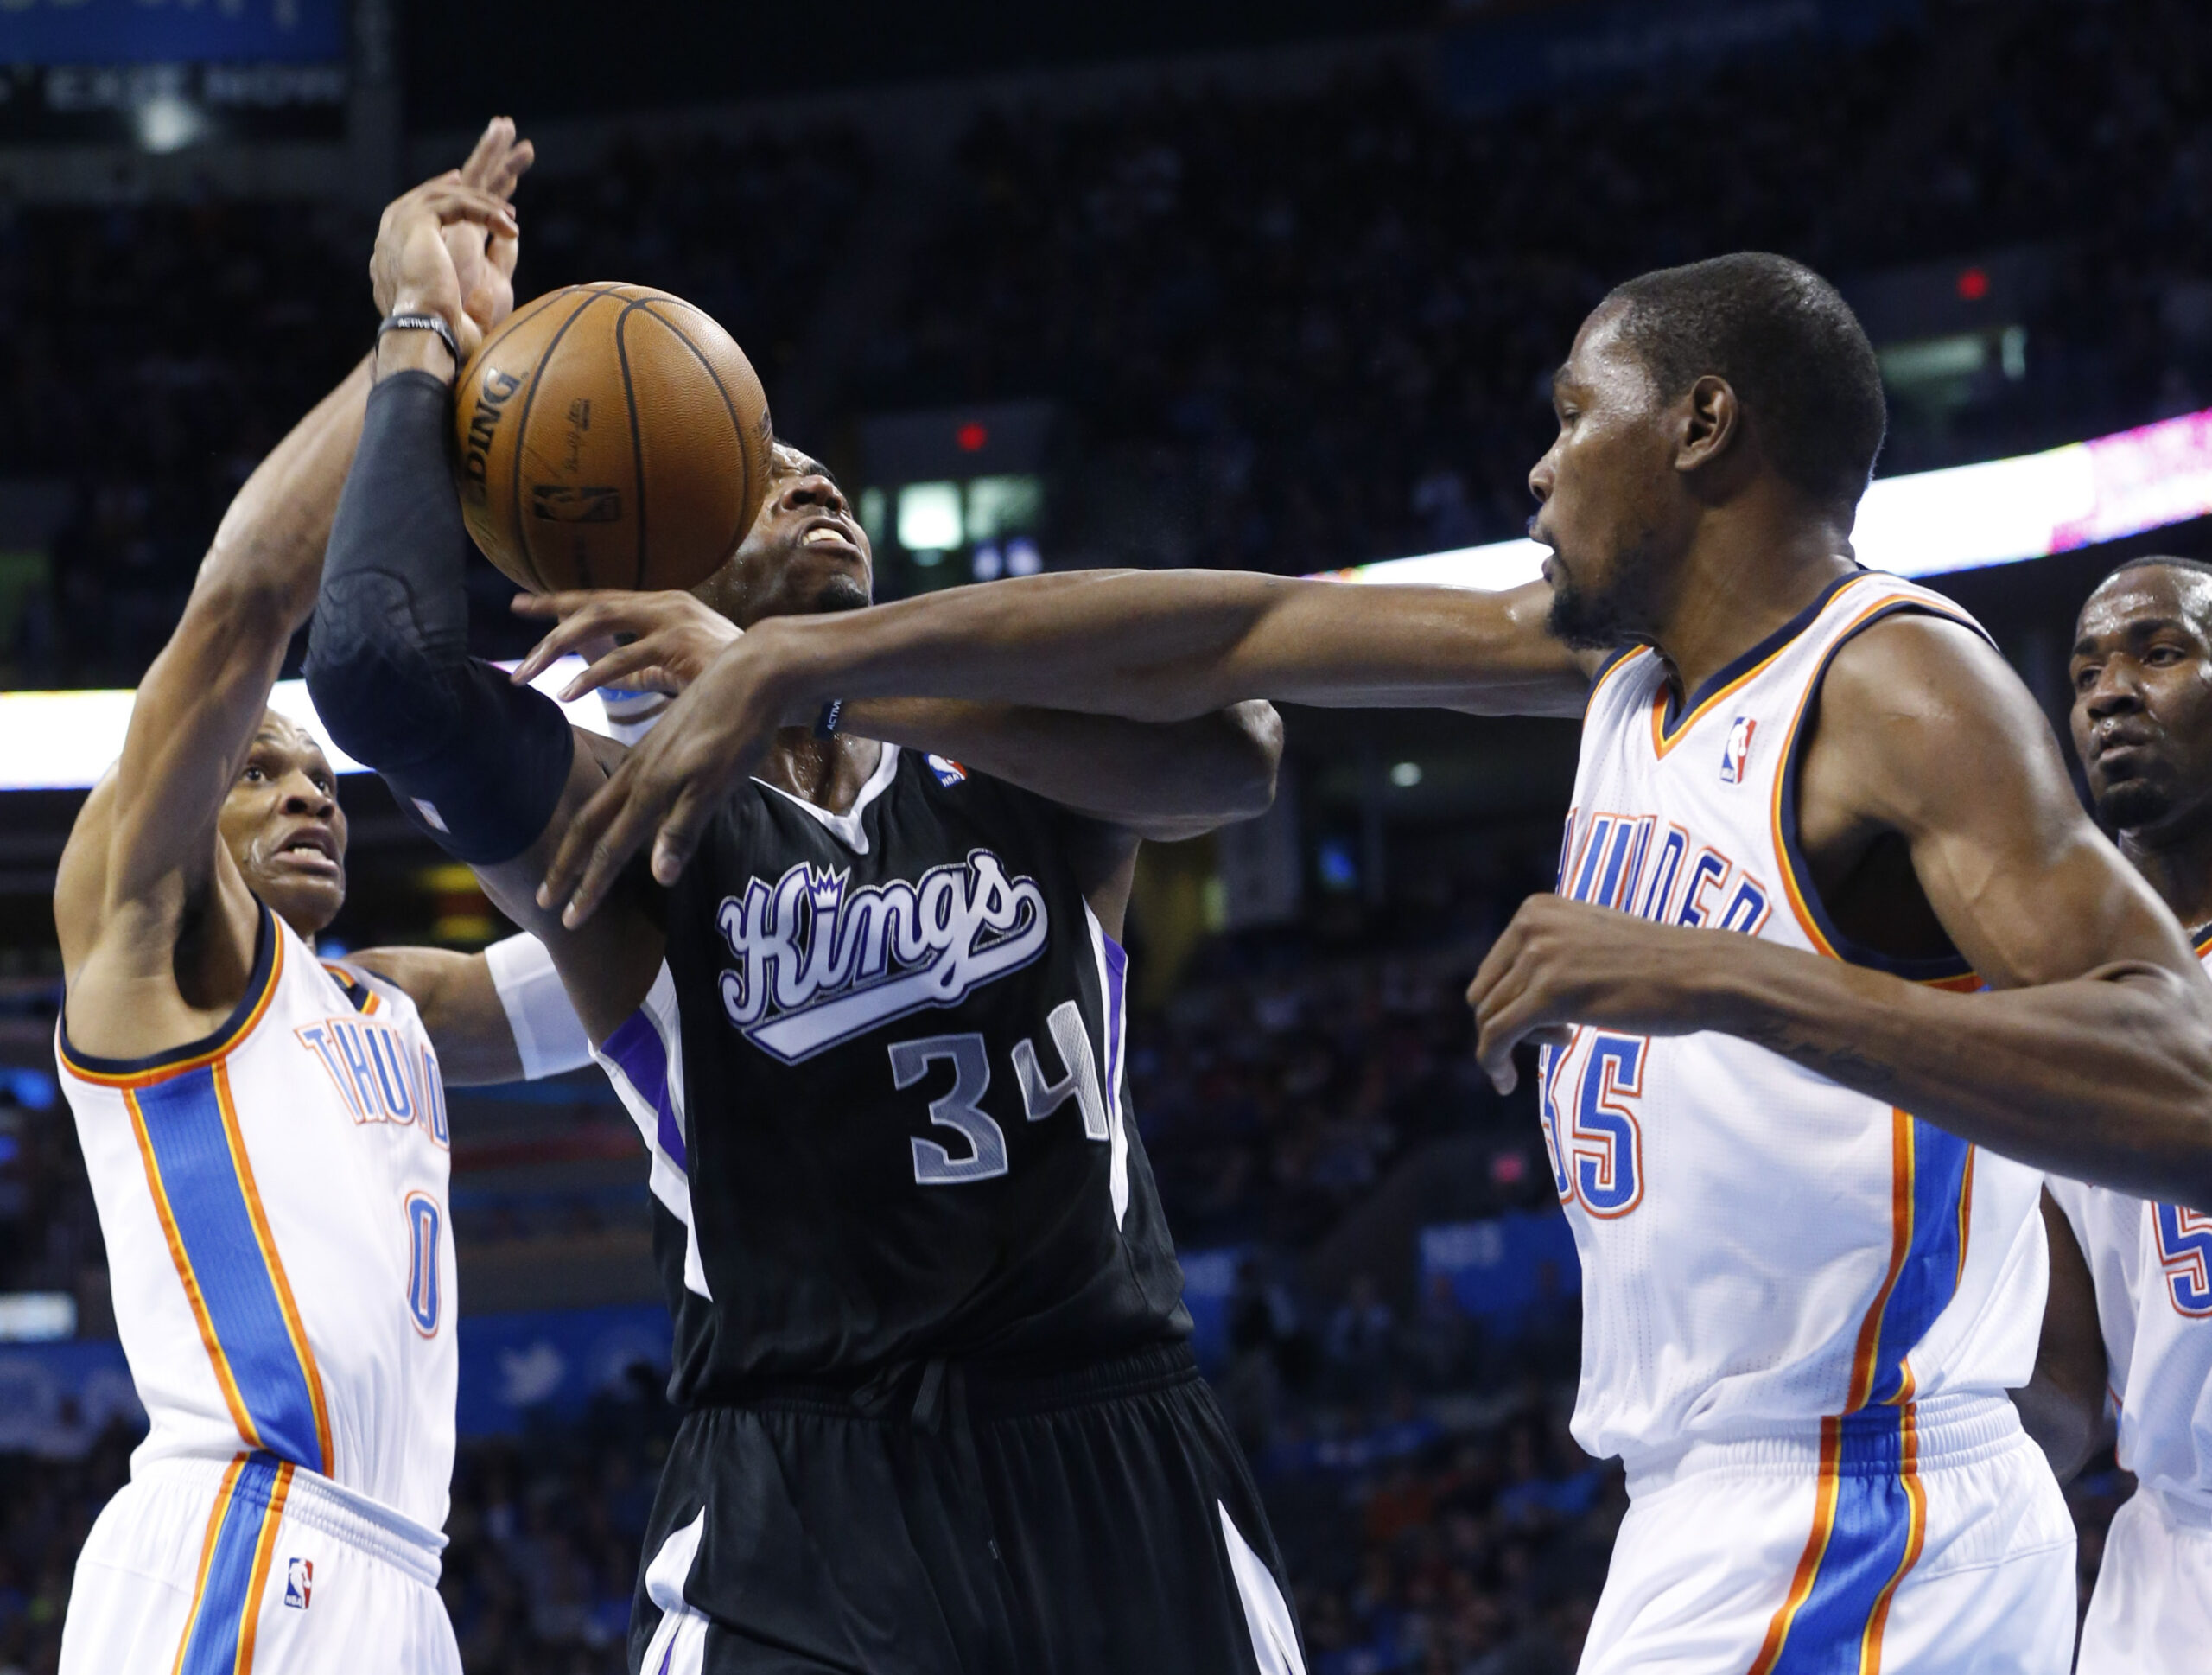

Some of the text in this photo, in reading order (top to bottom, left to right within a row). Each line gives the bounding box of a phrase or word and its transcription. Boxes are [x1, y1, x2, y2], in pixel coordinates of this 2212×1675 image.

[718, 848, 1049, 1065] Kings
[887, 1000, 1109, 1185] 34
[404, 1190, 442, 1340] 0
